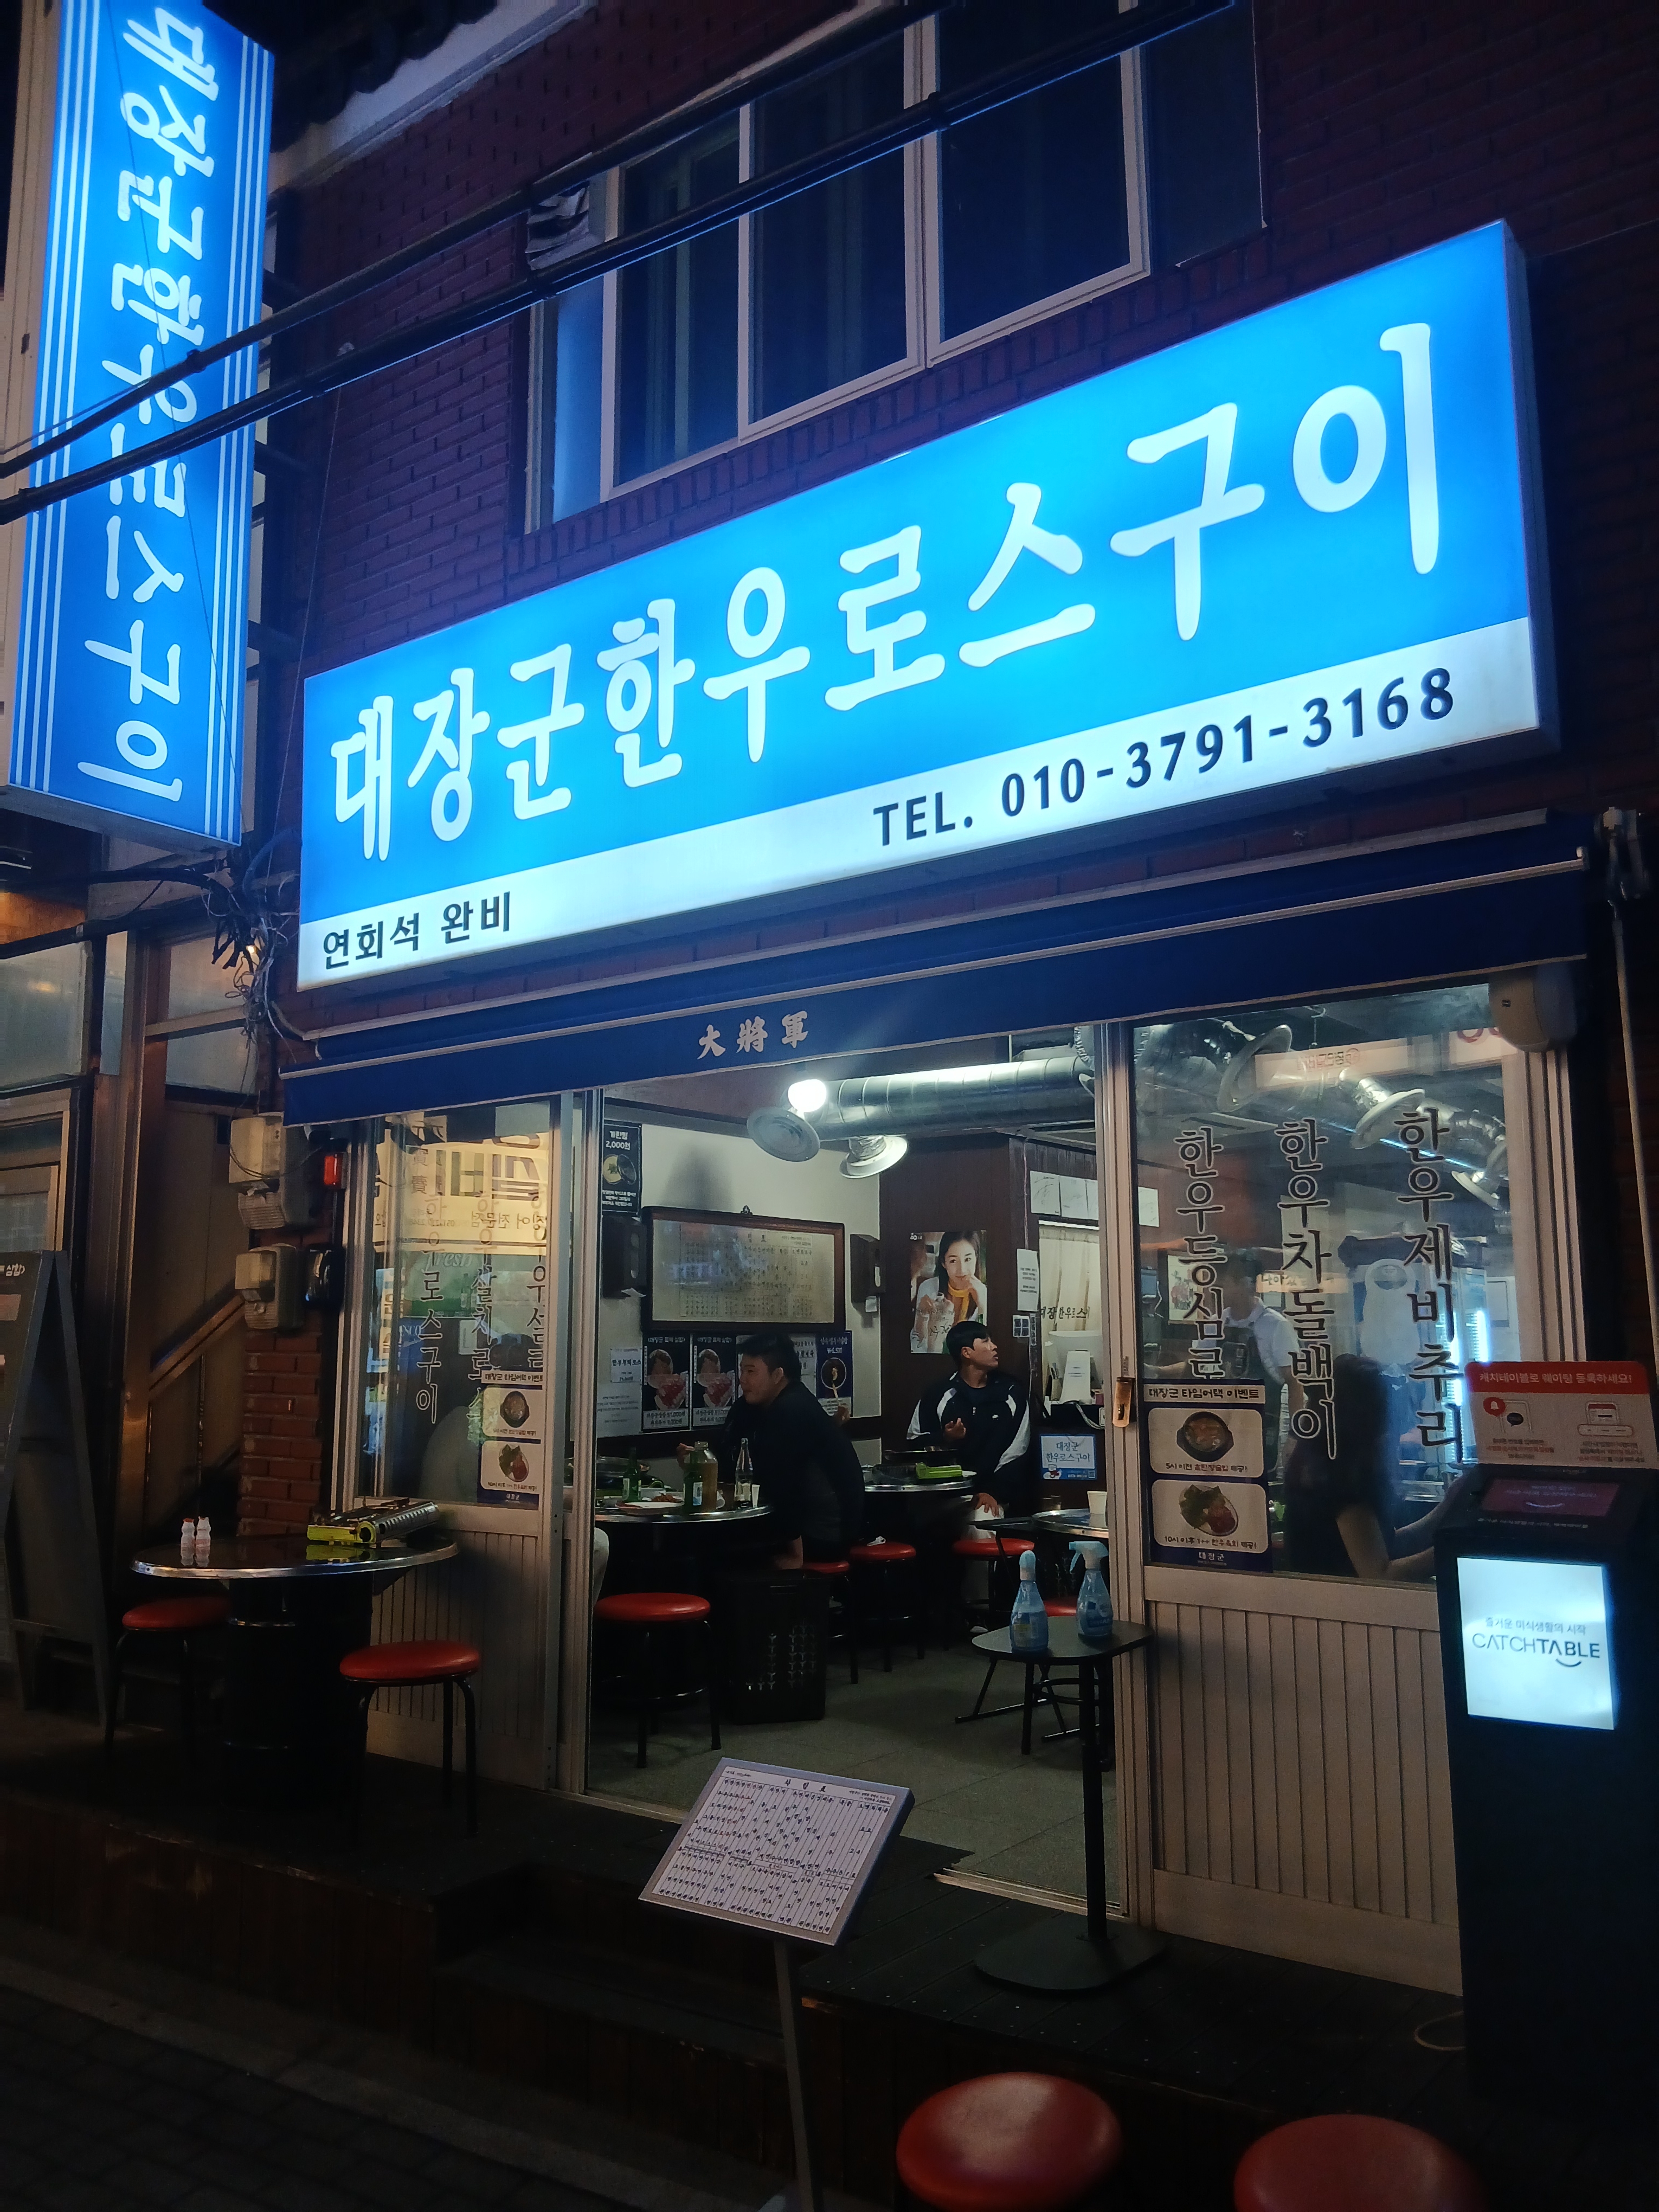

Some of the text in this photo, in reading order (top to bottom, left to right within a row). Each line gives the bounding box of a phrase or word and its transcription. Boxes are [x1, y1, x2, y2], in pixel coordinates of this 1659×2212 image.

[78, 7, 218, 802] 대장군한우로스구이
[330, 323, 1439, 861] 대장군한우로스구이
[873, 667, 1455, 847] TEL. 010-3791-3168
[323, 891, 511, 970] 연회석 완비
[697, 1010, 808, 1060] 大將軍
[606, 1140, 631, 1150] 2,000원
[1275, 1118, 1338, 1460] 한우차돌백이
[1394, 1107, 1464, 1464] 한우제비추리
[1148, 1388, 1259, 1400] 대장군 타임어택 이벤트
[1480, 1372, 1540, 1384] 캐치테이블로
[1046, 1452, 1090, 1463] 한우로스구이
[1198, 1552, 1225, 1562] 대장군
[1472, 1632, 1600, 1658] CATCHTABLE
[1485, 1616, 1586, 1636] 즐거운 미식생활의 시작
